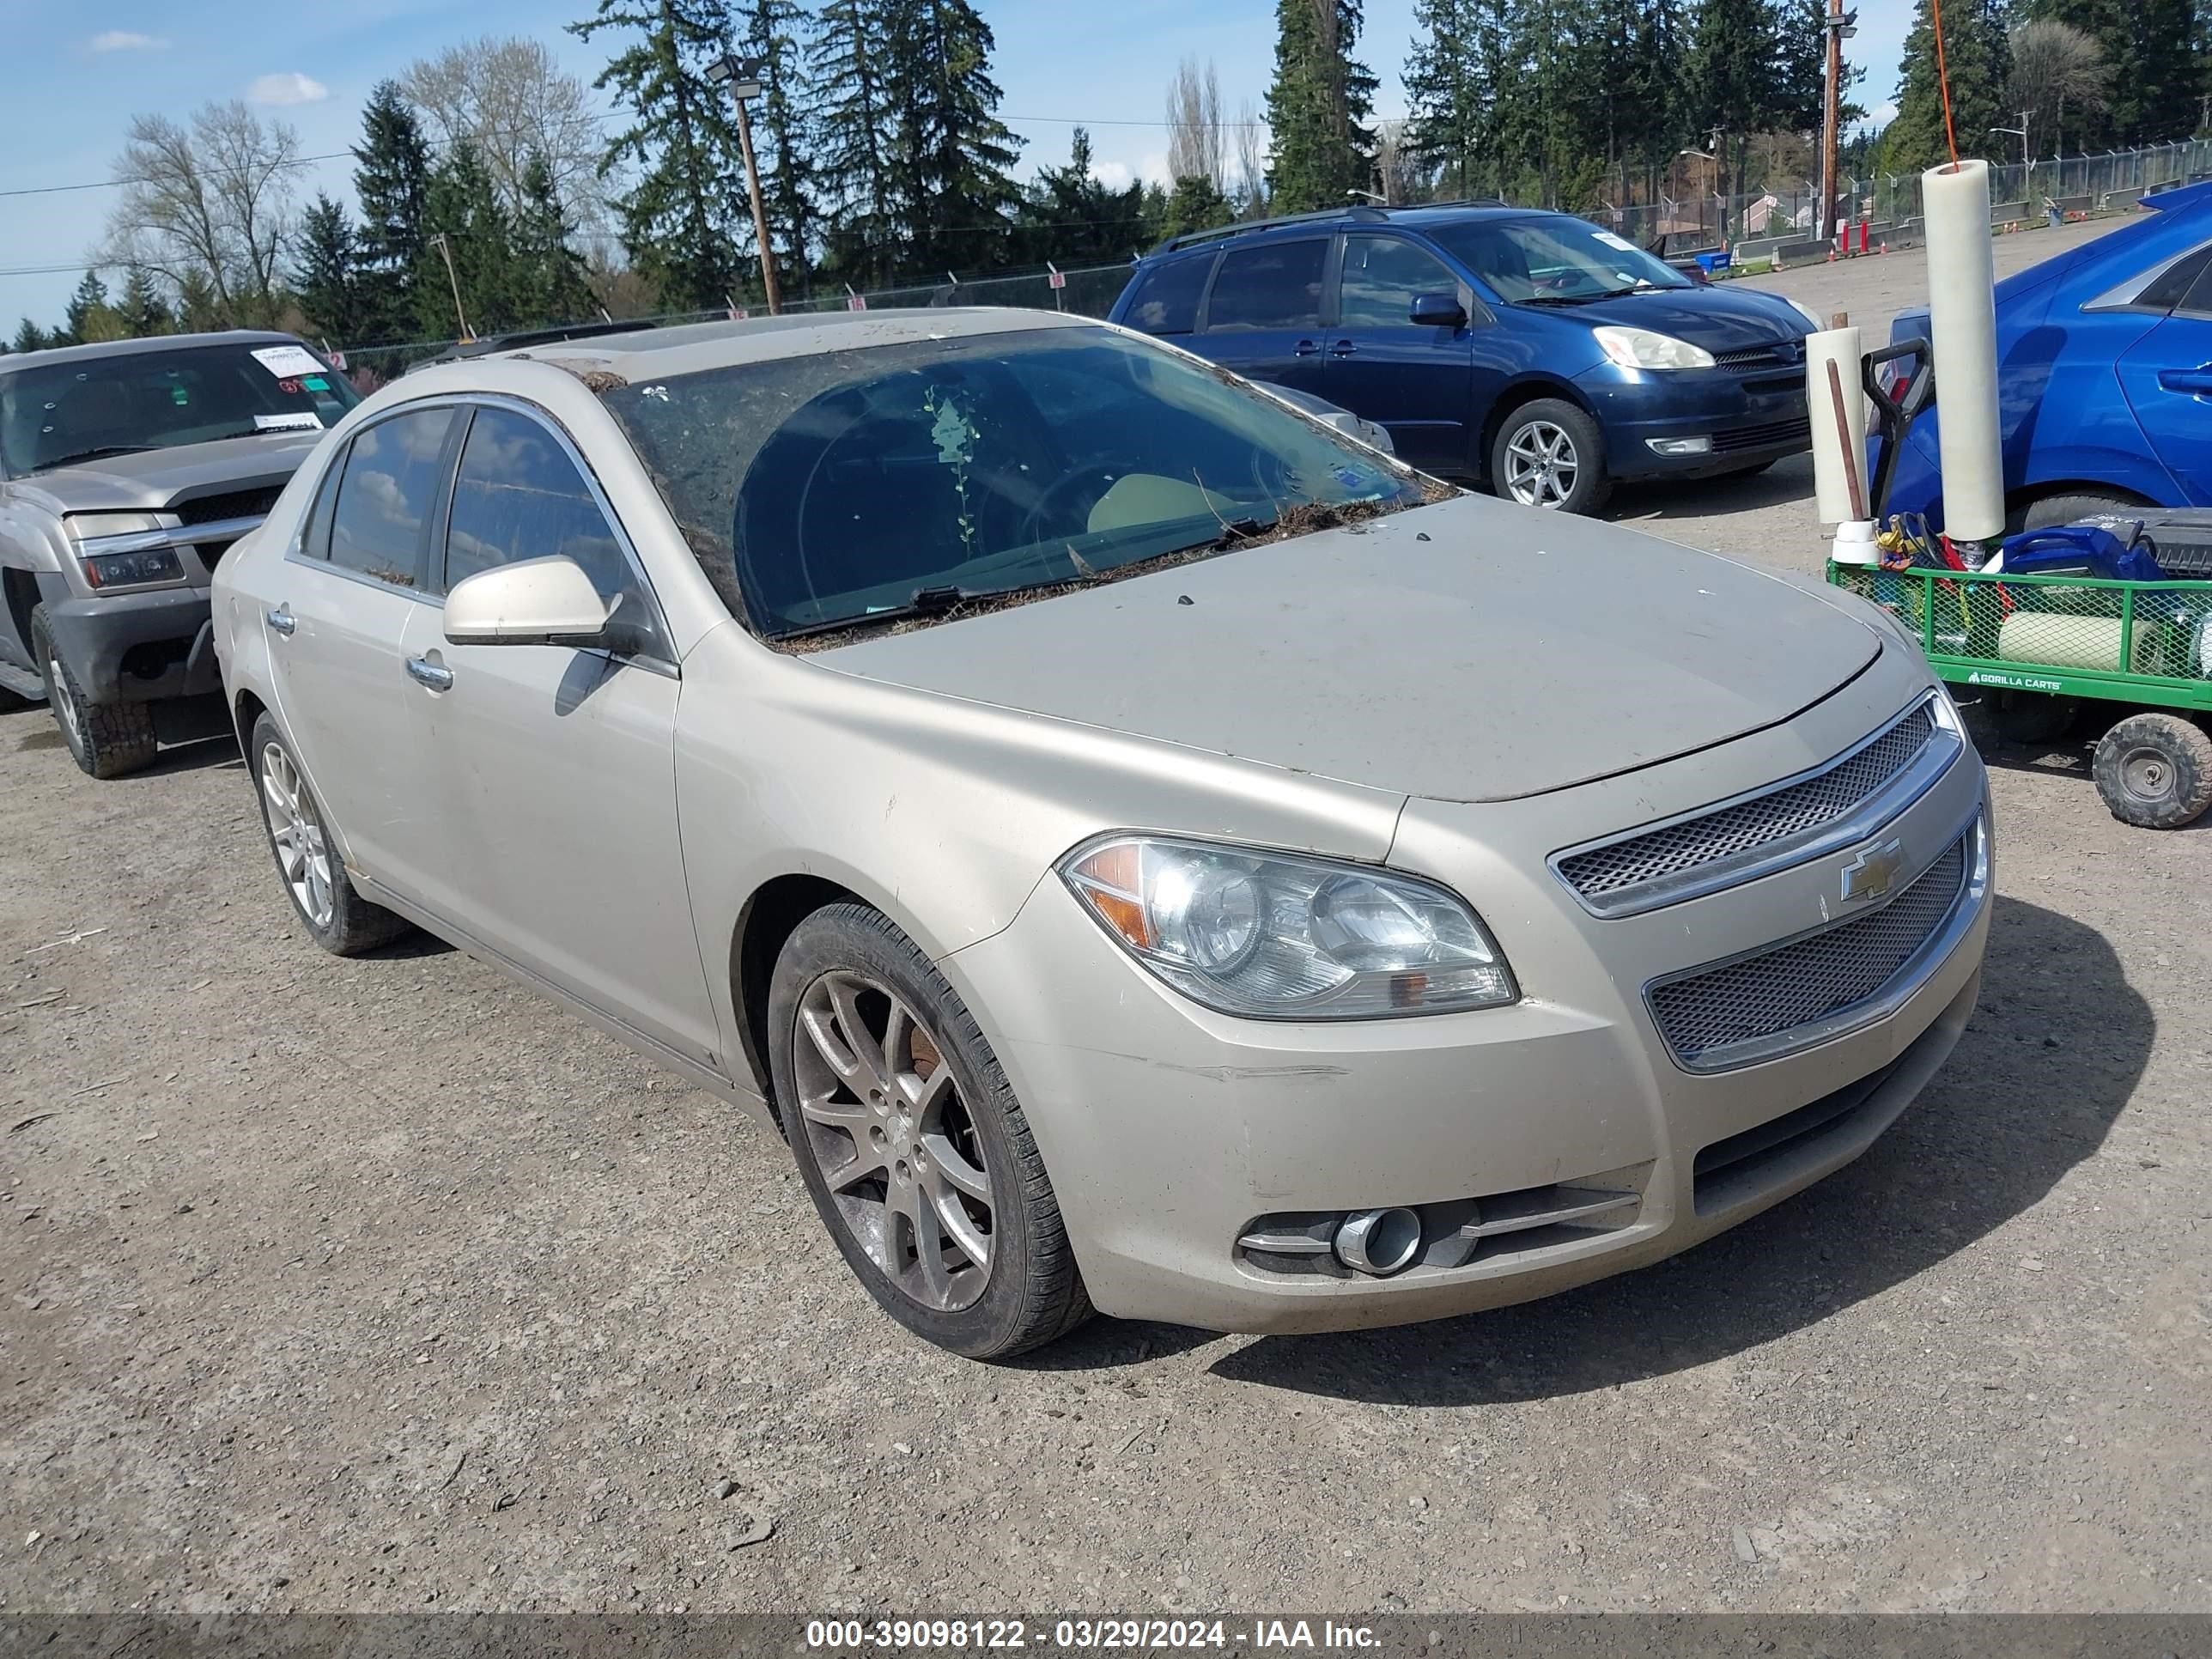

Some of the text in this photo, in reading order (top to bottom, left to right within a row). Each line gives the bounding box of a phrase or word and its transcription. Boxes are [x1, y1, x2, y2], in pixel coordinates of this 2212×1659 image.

[1765, 196, 1776, 206] 29
[1980, 673, 2060, 690] GORILLA CARTS
